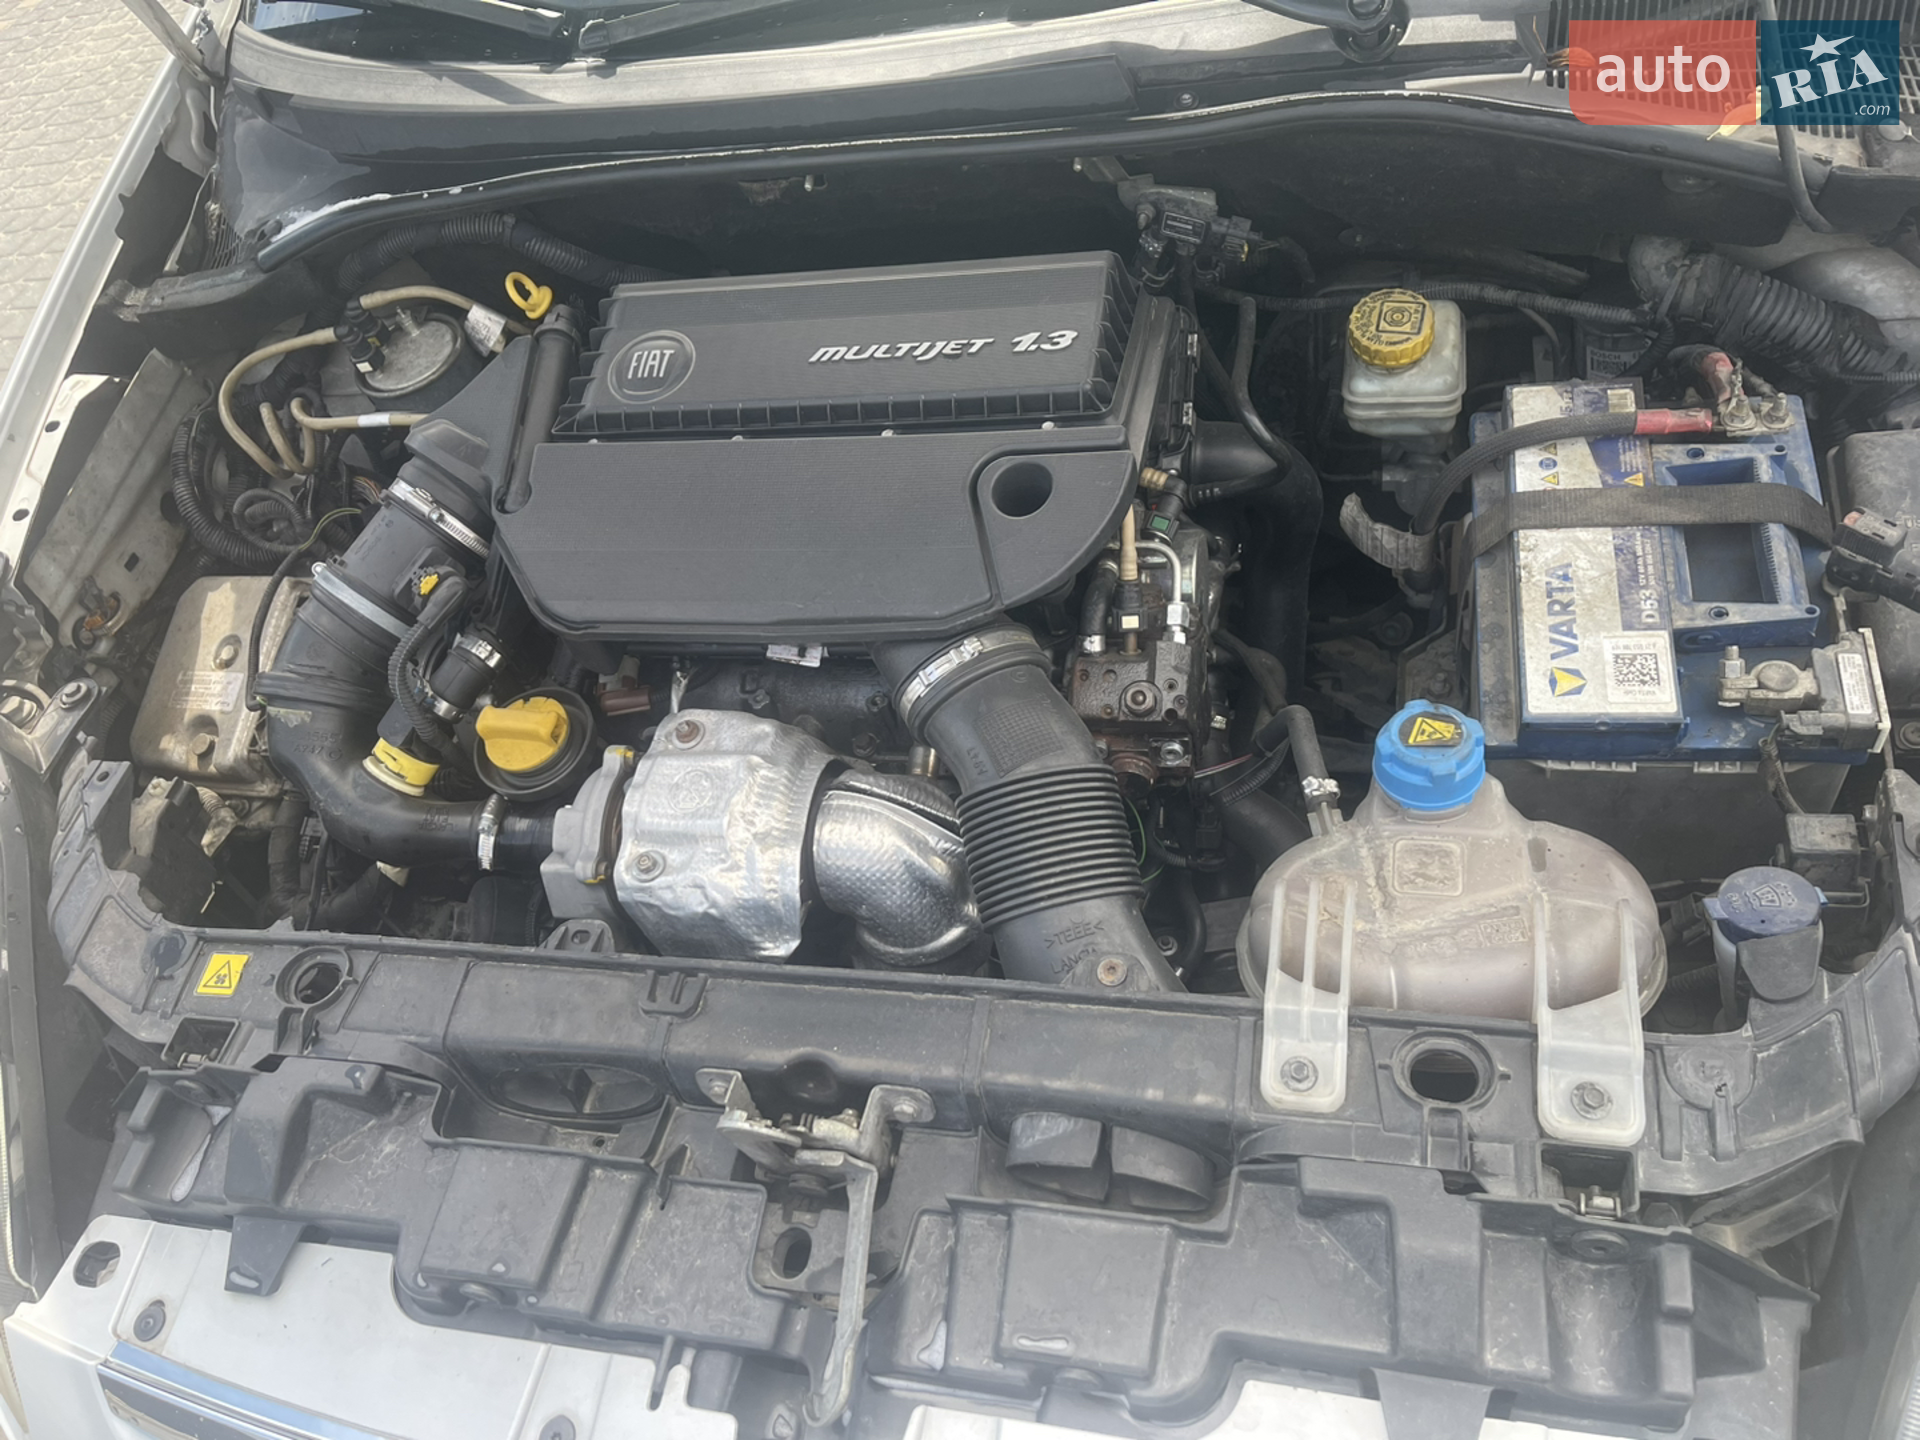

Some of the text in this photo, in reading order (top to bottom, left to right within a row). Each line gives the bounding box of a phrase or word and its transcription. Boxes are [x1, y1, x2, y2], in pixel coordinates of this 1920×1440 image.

[626, 348, 676, 381] FIAT
[808, 328, 1080, 365] MULTIJET 1.3
[1590, 348, 1621, 361] BOSCH
[1545, 562, 1579, 661] VARTA
[1639, 589, 1660, 625] D53
